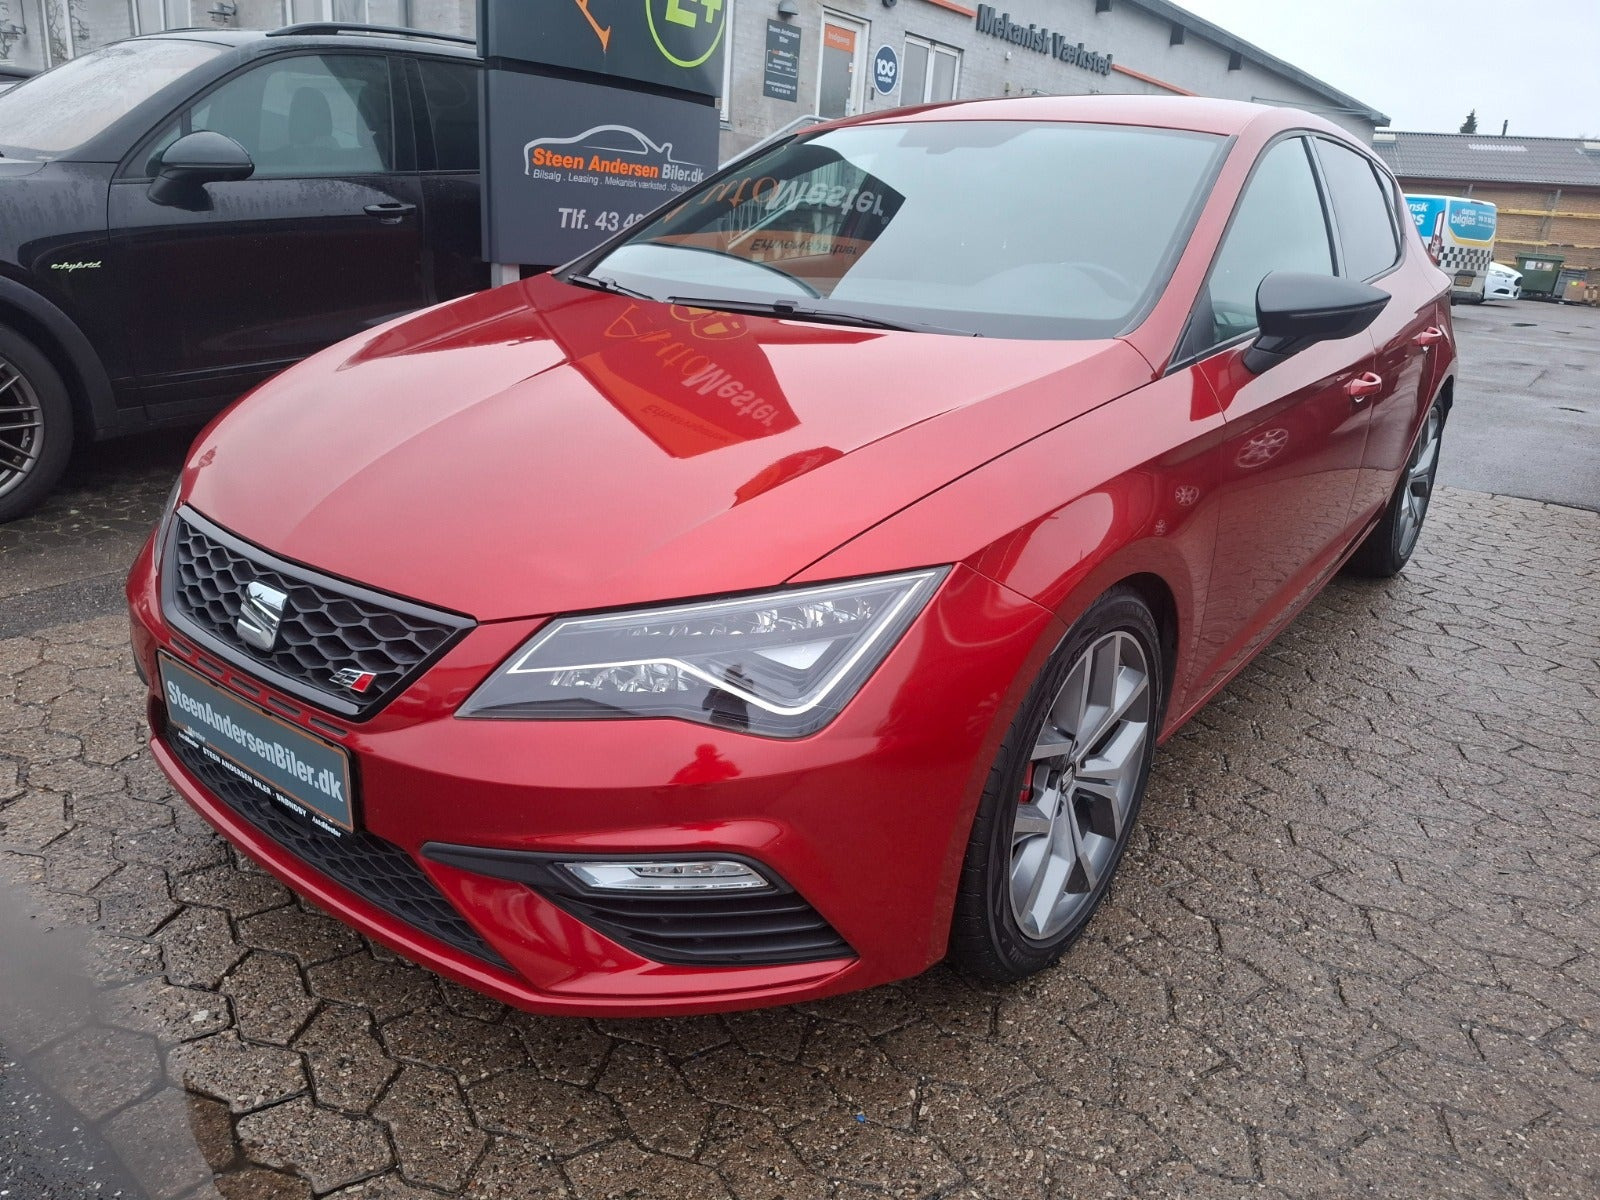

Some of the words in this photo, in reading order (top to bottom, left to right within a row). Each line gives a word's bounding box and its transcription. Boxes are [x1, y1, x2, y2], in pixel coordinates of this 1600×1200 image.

[976, 3, 1051, 55] Mekanisk
[1052, 32, 1113, 76] Værksted
[532, 148, 585, 170] Steen
[588, 155, 659, 179] Andersen
[662, 163, 704, 183] Biler.dk
[533, 169, 561, 182] Bilsalg
[568, 174, 599, 186] Leasing
[605, 176, 637, 189] Mekanisk
[638, 179, 667, 191] værksted
[558, 208, 589, 230] Tlf.
[595, 211, 619, 231] 43
[1451, 214, 1476, 227] bilglas
[167, 680, 344, 802] SteenAndersenBiler.dk
[203, 747, 221, 763] STEEN
[222, 758, 253, 784] ANDERSEN
[254, 778, 271, 796] BILER
